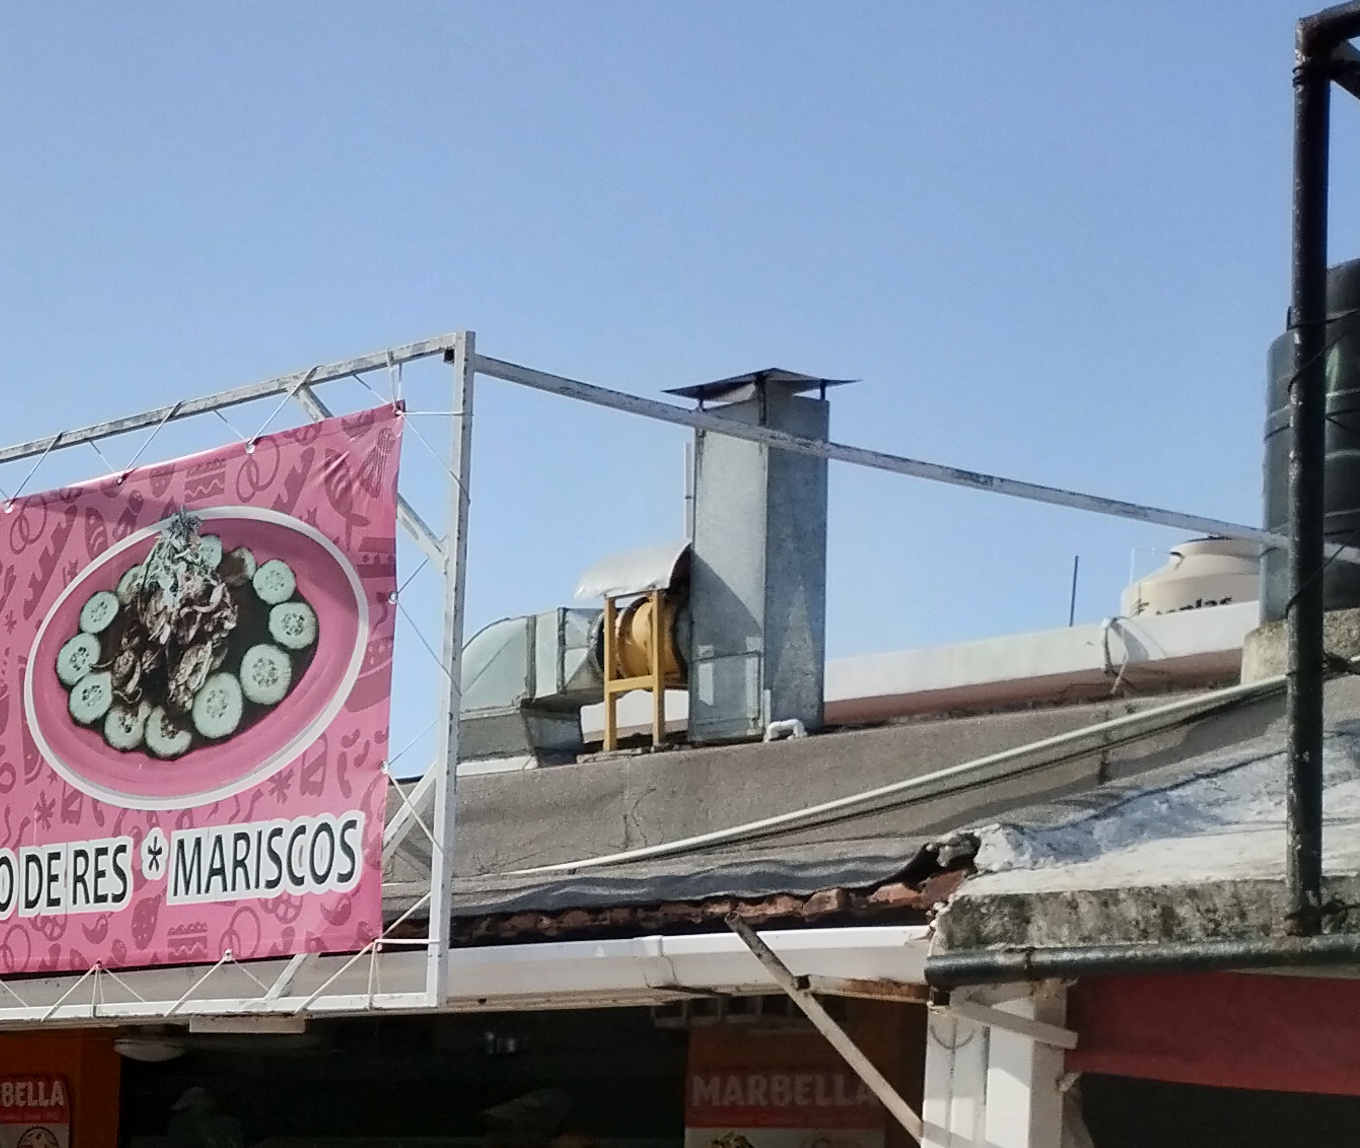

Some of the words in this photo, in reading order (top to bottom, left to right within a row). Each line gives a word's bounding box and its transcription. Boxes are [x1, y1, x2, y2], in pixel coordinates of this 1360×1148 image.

[22, 848, 62, 909] DE
[73, 844, 128, 905] RES
[173, 819, 357, 897] MARISCOS
[691, 1073, 880, 1107] MARBELLA
